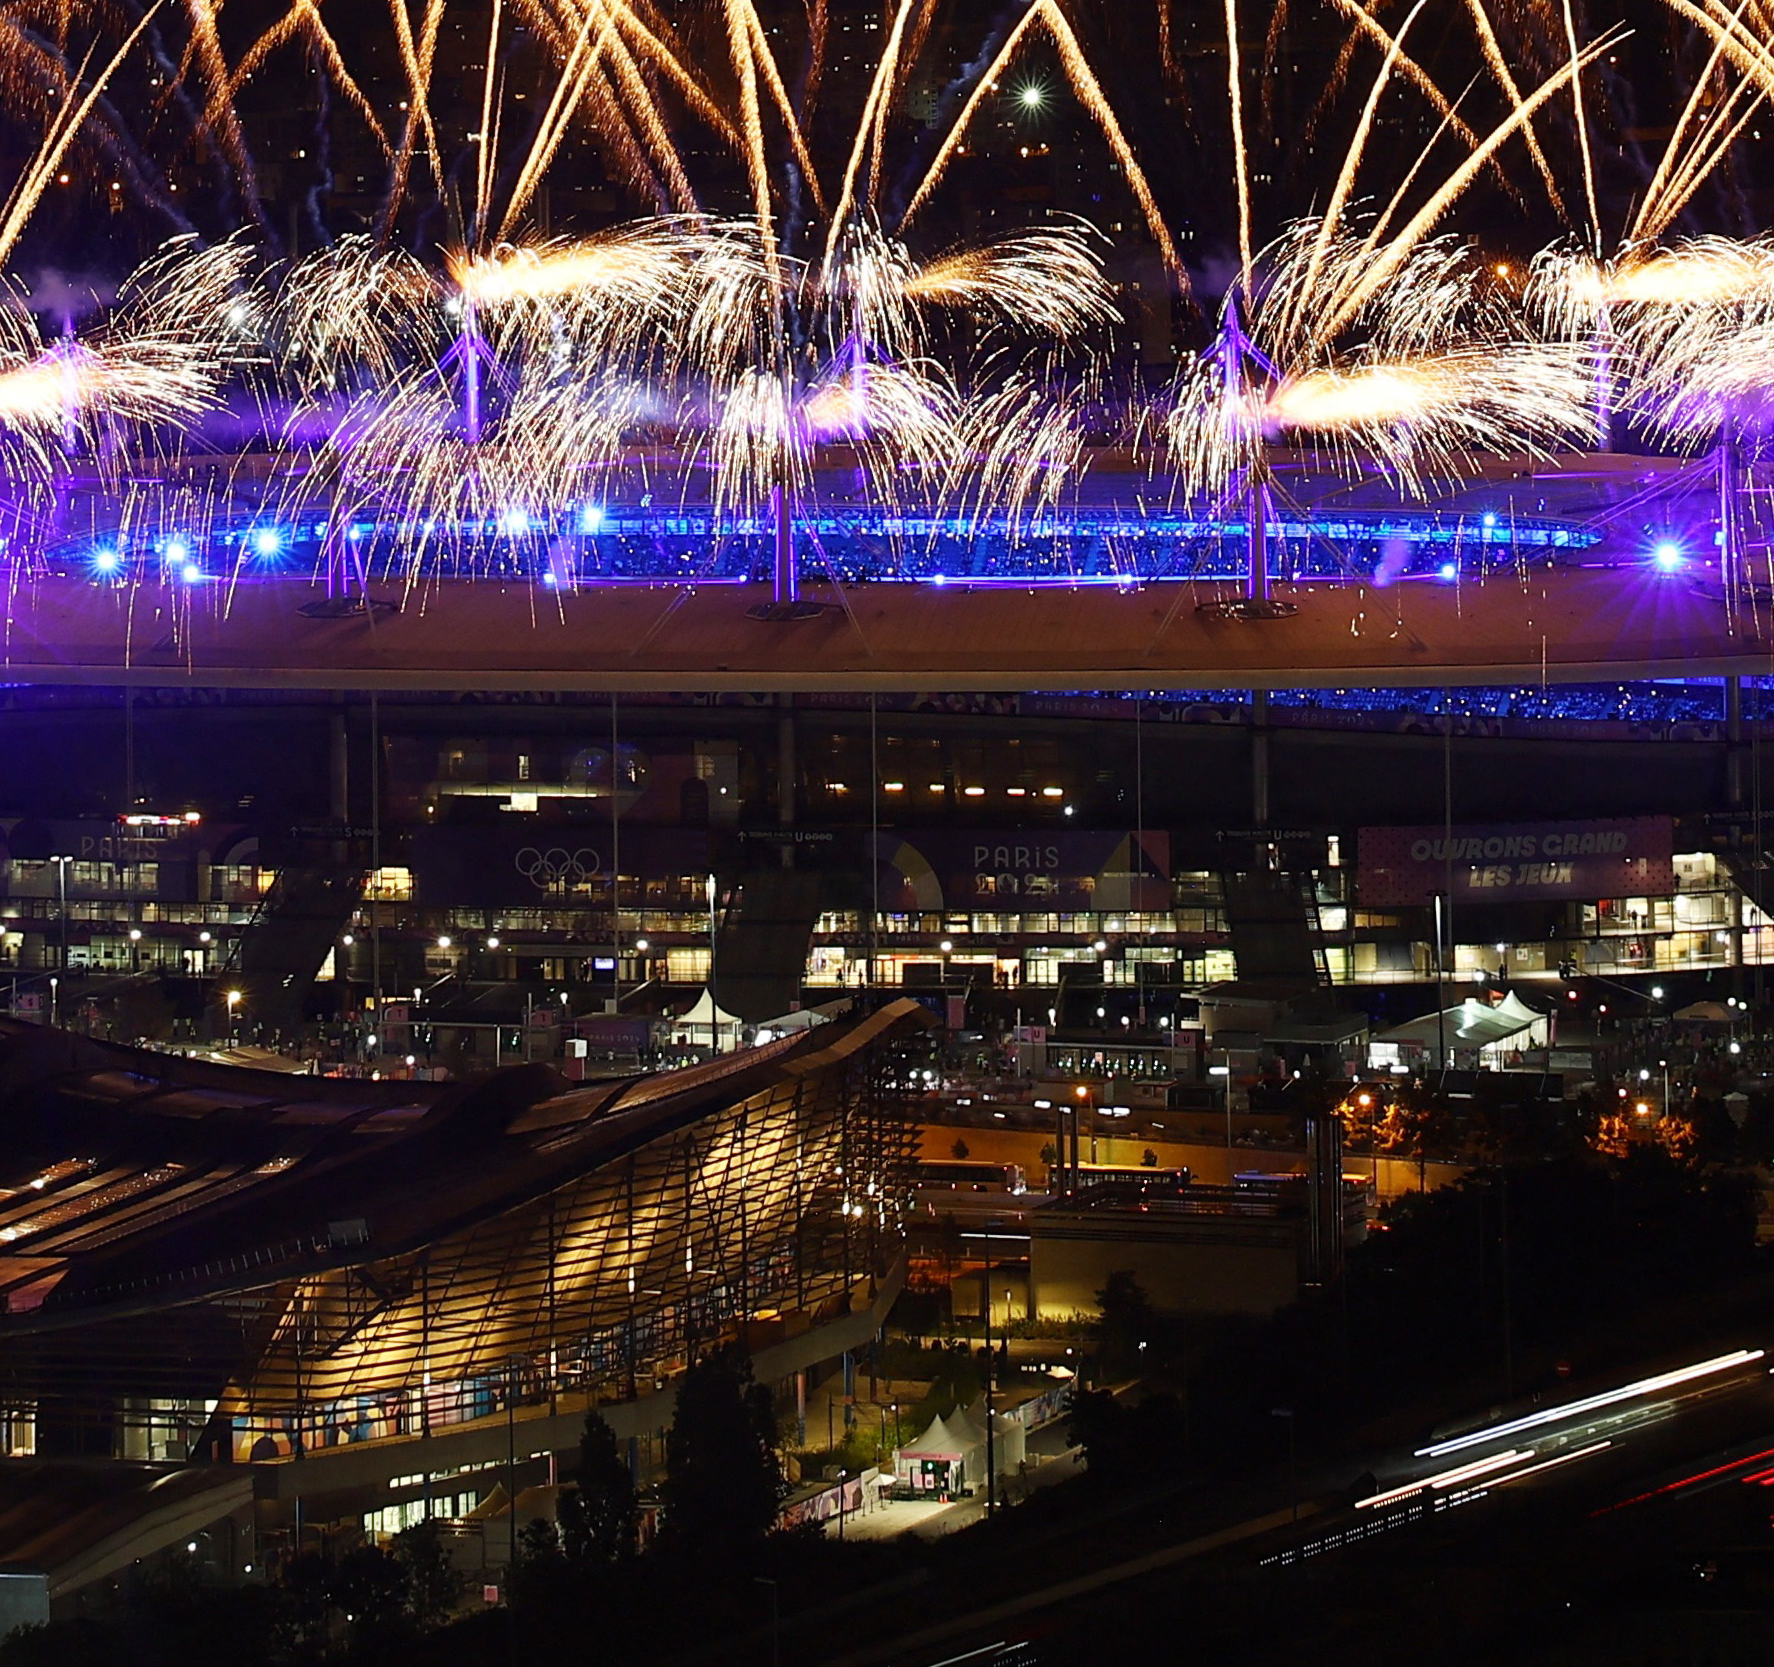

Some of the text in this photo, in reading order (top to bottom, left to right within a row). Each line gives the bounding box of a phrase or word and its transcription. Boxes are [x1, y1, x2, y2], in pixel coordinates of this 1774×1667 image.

[81, 836, 158, 860] PARIS
[974, 846, 1059, 868] PARIS
[1411, 831, 1628, 861] OUVRONS GRAND
[1468, 861, 1575, 887] LES JEUX
